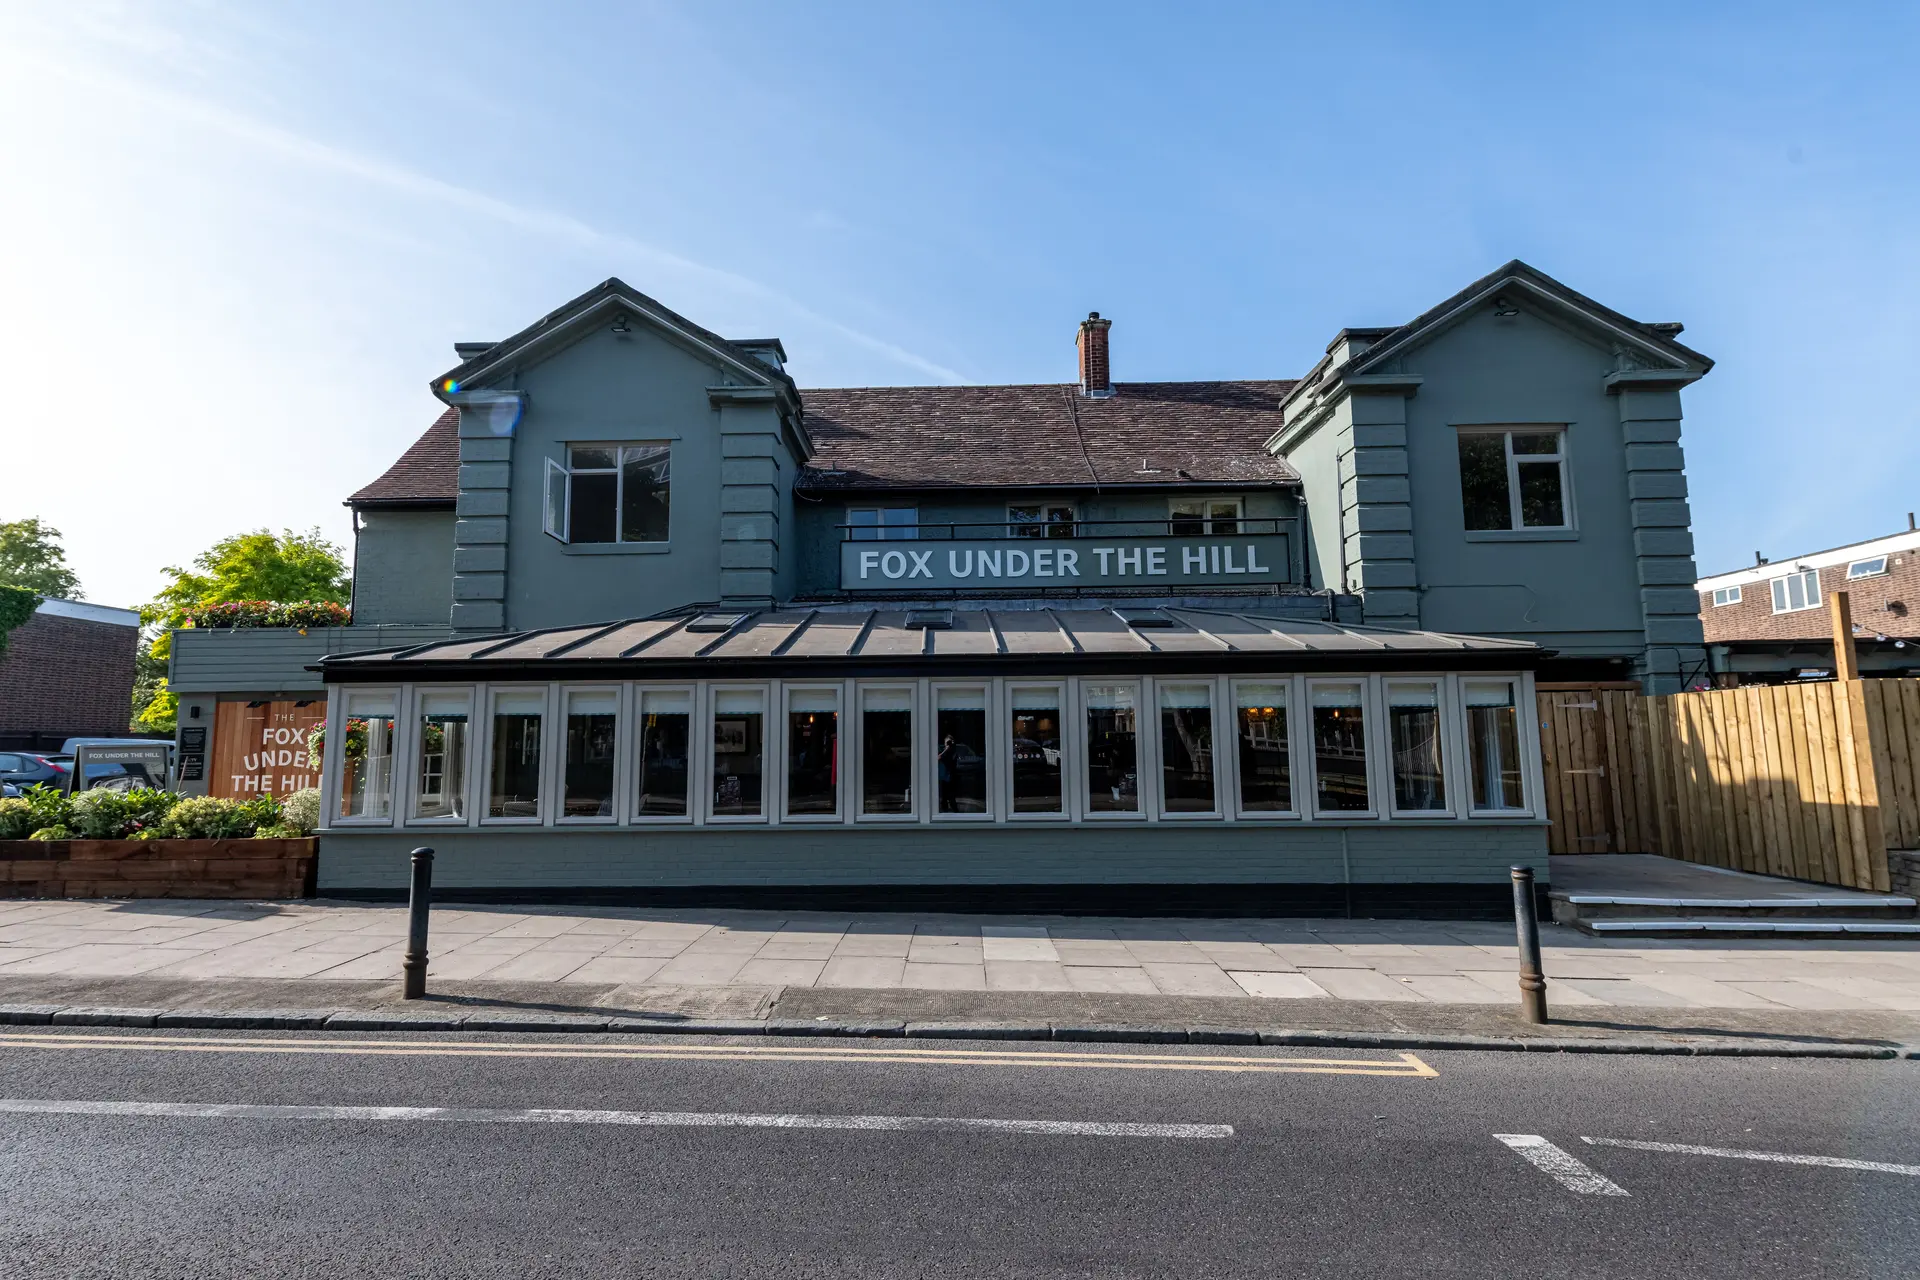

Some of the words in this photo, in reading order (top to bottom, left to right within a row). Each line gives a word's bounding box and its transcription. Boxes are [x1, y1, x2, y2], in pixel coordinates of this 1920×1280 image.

[860, 550, 934, 579] FOX
[949, 548, 1081, 578] UNDER
[1093, 547, 1167, 576] THE
[1182, 545, 1270, 575] HILL
[274, 713, 295, 721] THE
[262, 728, 306, 745] FOX
[231, 774, 273, 792] THE
